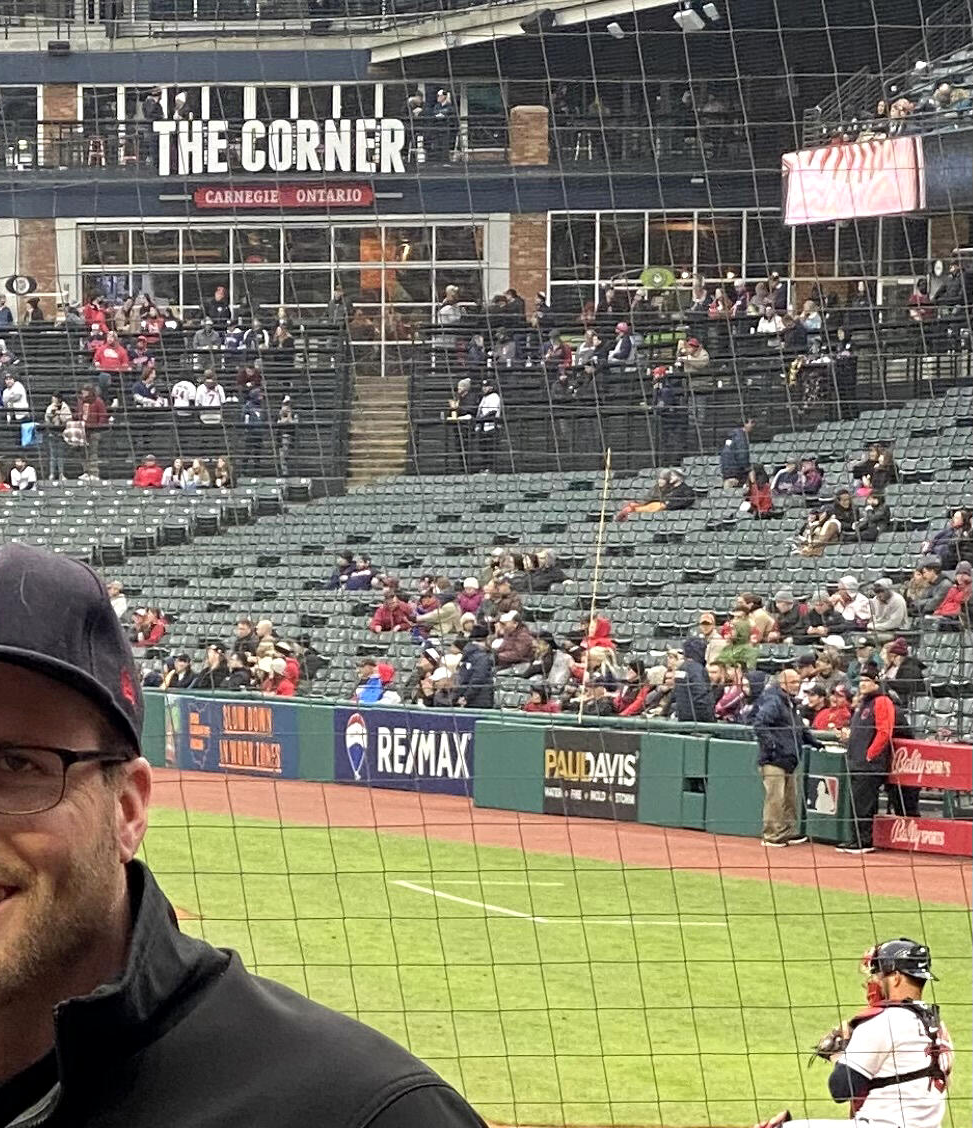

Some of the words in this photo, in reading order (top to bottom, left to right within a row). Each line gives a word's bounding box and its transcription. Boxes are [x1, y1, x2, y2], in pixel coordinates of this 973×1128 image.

[152, 119, 228, 177] THE
[241, 118, 406, 174] CORNER
[204, 189, 278, 204] CARNEGIE
[296, 187, 362, 203] ONTARIO
